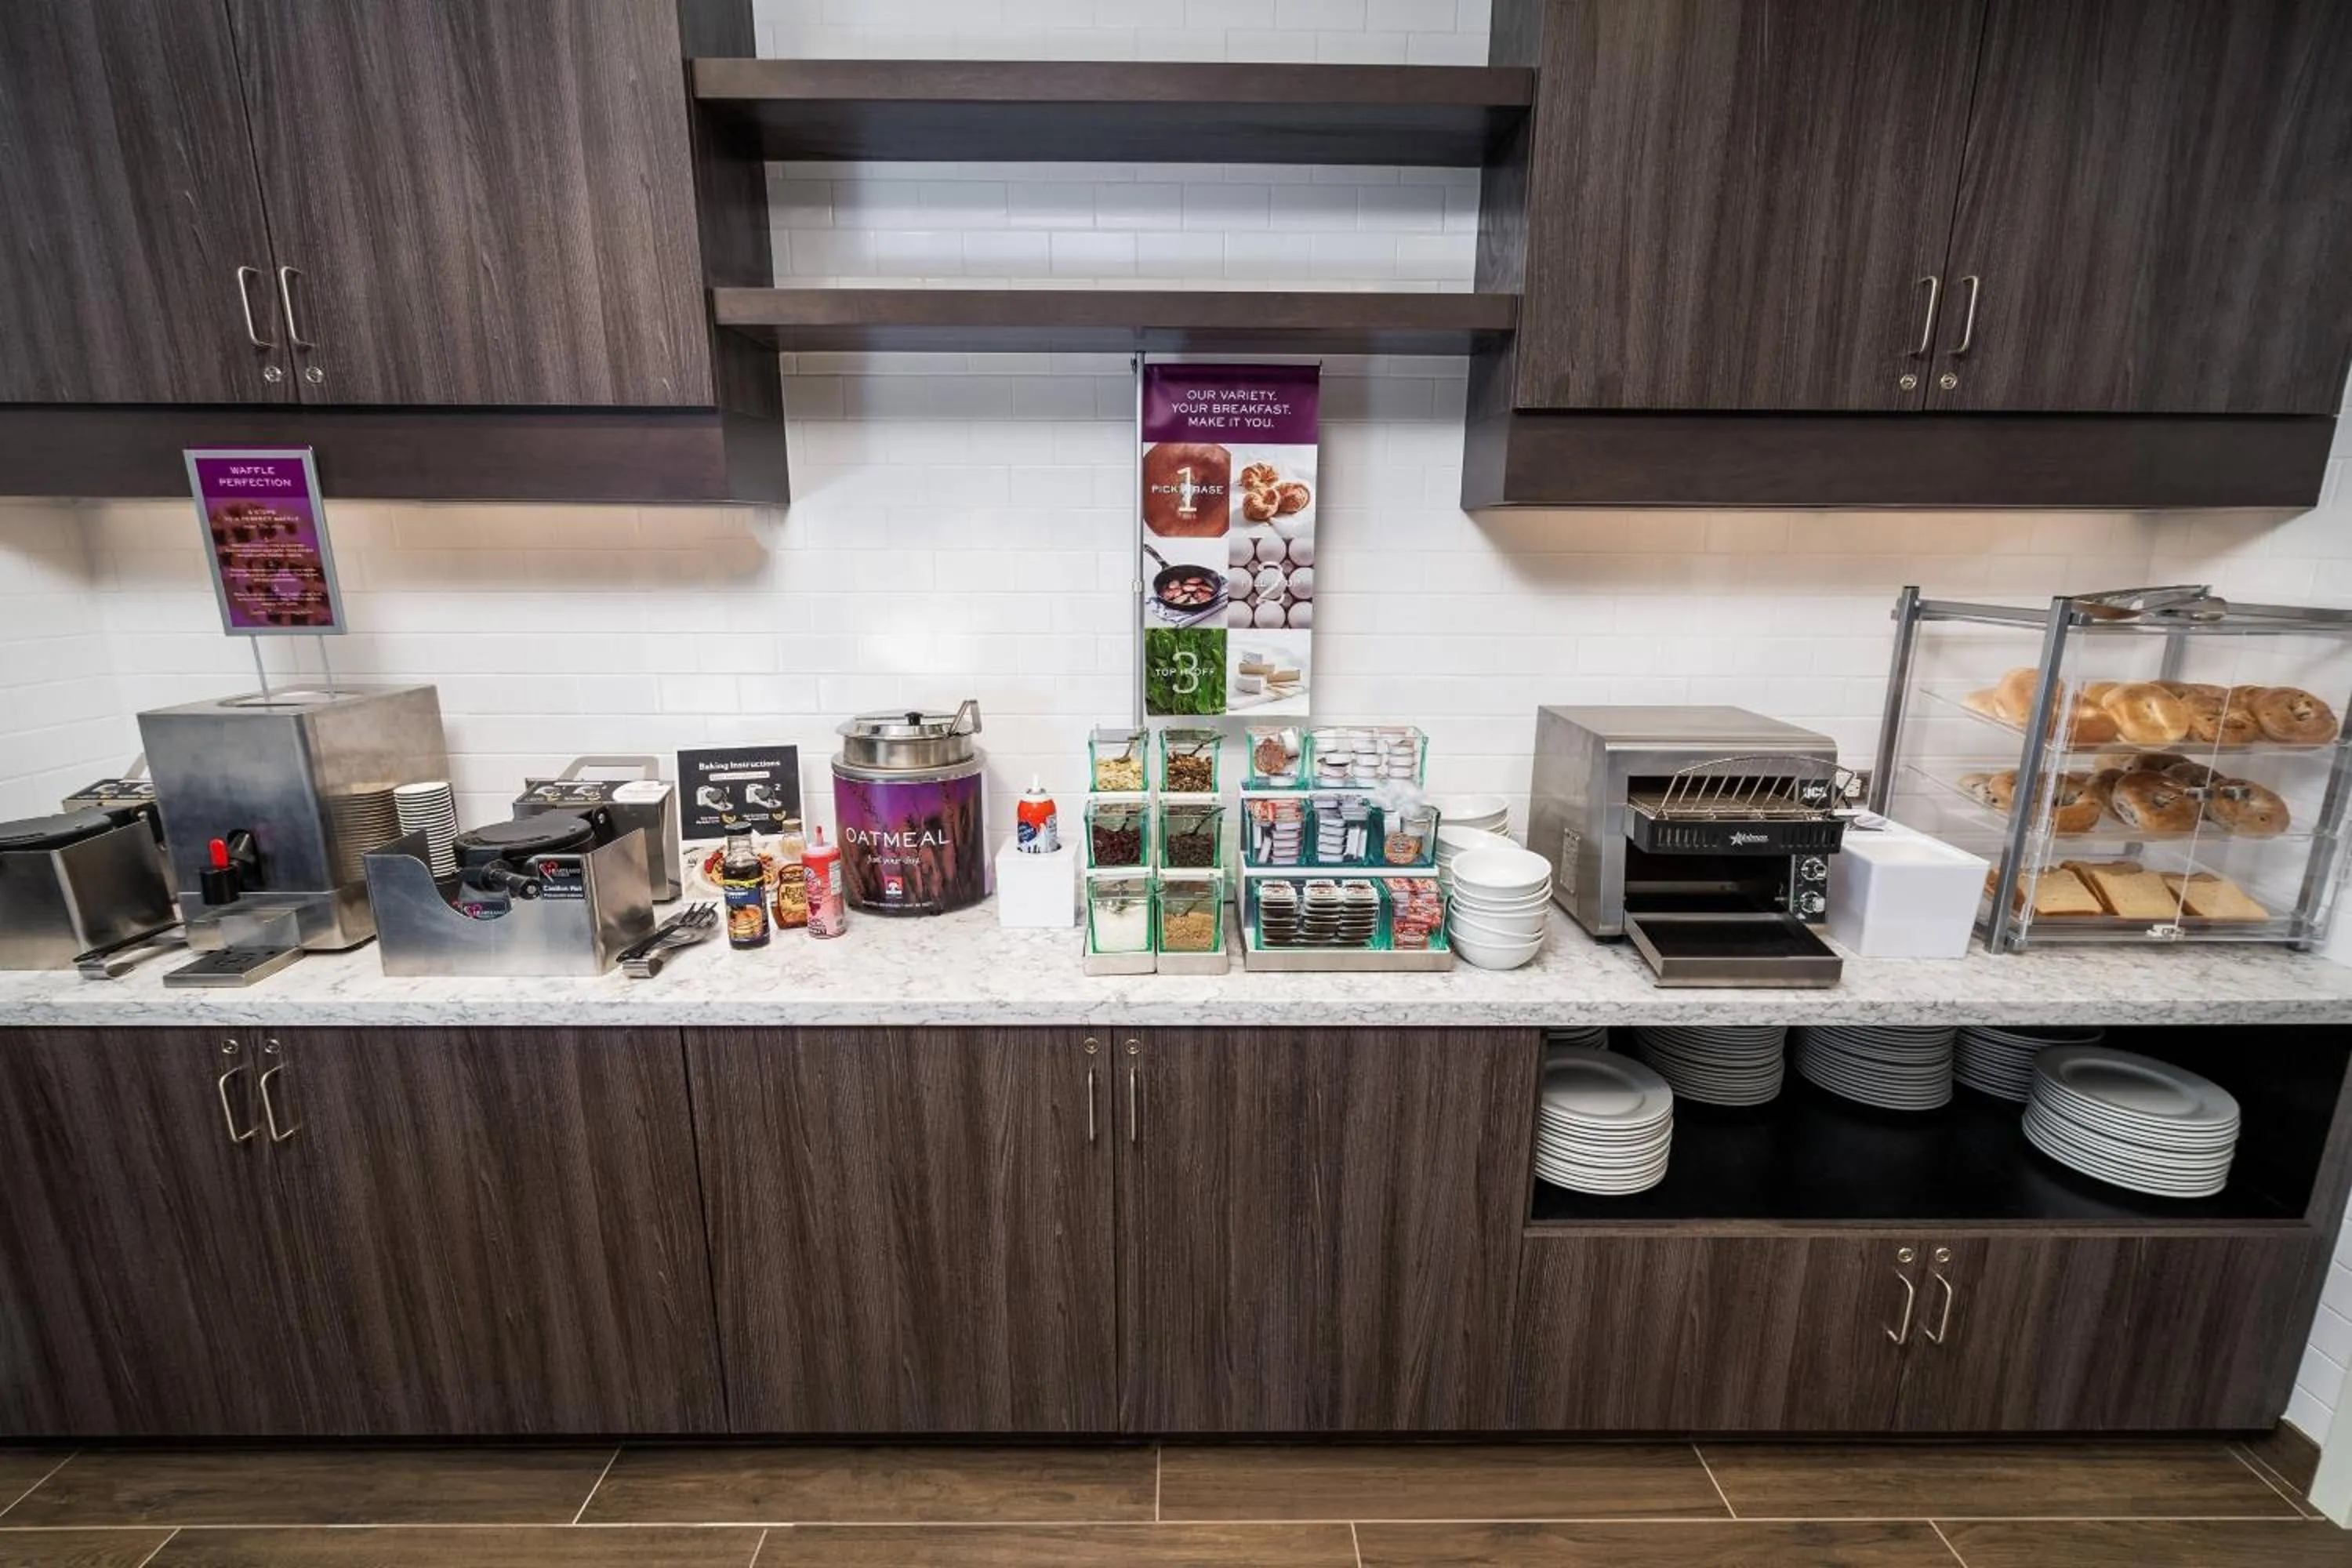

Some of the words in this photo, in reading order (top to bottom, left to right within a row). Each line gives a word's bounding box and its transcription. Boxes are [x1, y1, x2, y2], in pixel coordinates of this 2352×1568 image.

[1186, 390, 1215, 401] OUR
[1220, 390, 1277, 401] VARIETY.
[1172, 403, 1208, 414] YOUR
[1212, 404, 1291, 415] BREAKFAST.
[1188, 416, 1225, 427] MAKE
[1229, 417, 1240, 427] IT
[1244, 417, 1274, 428] YOU.
[229, 466, 276, 475] WAFFLE
[219, 477, 292, 487] PERFECTION
[1151, 485, 1178, 495] PICK
[1177, 466, 1197, 512] 1
[1257, 561, 1287, 604] 2
[1155, 668, 1177, 677] TOP
[1172, 652, 1200, 694] 3
[699, 761, 729, 771] Baking
[730, 760, 781, 769] Instructions
[846, 827, 951, 848] OATMEAL
